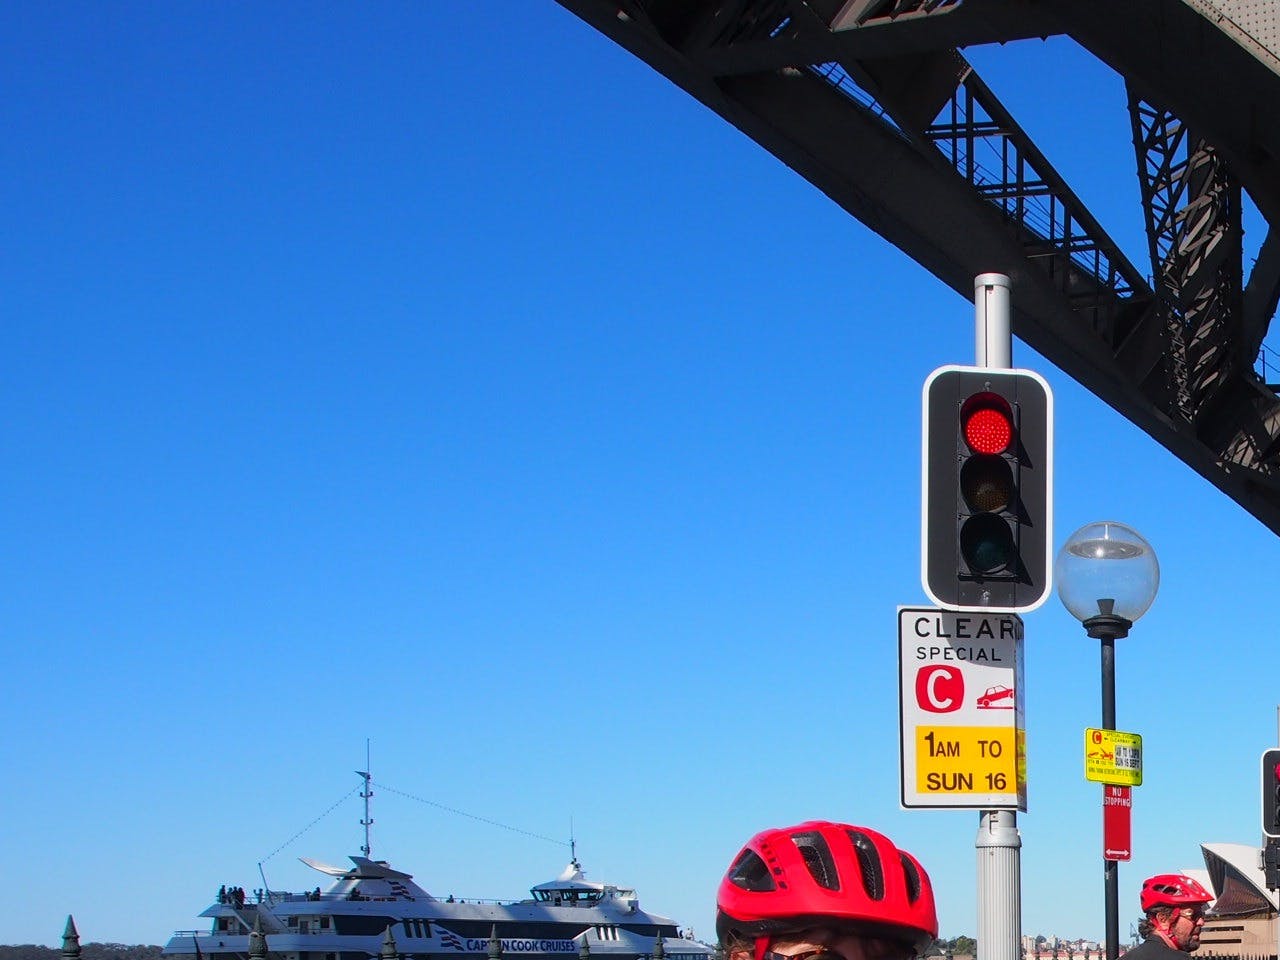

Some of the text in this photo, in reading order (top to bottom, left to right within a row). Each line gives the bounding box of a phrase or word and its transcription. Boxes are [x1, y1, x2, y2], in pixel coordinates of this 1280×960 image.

[916, 646, 1002, 661] SPECIAL
[926, 668, 953, 710] C
[924, 731, 1003, 758] 1AM TO
[926, 772, 1007, 791] SUN 16
[1112, 787, 1122, 796] NO
[1105, 797, 1131, 807] STOPPING
[512, 940, 538, 951] COOK
[540, 940, 575, 951] CRUISES
